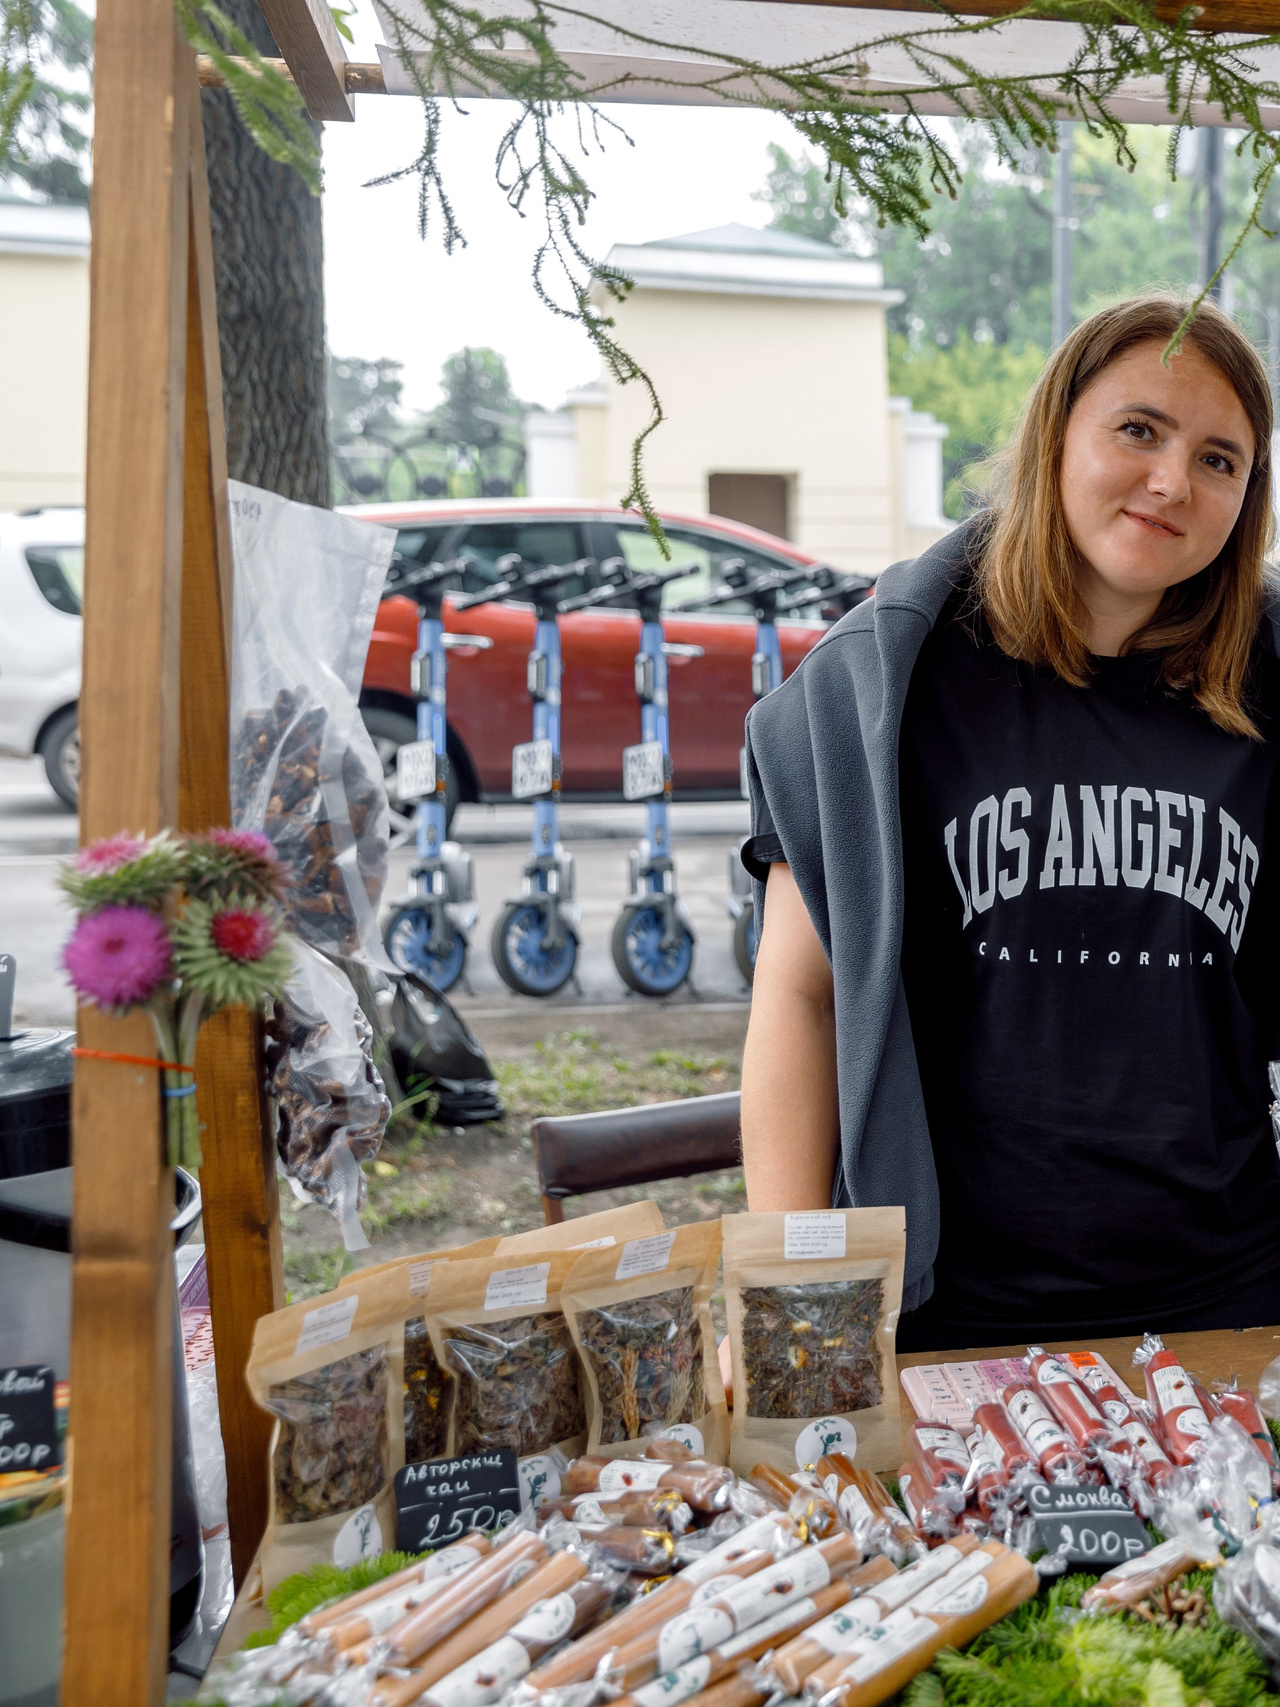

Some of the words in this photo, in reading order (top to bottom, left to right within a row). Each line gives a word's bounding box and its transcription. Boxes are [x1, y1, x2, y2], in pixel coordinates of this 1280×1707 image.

[943, 786, 1033, 931] LOS
[1039, 783, 1260, 955] ANGELES
[978, 941, 1214, 967] CALIFORNIA
[404, 1453, 504, 1484] Авторские
[1030, 1484, 1129, 1510] Смоква
[1057, 1523, 1145, 1559] 200р
